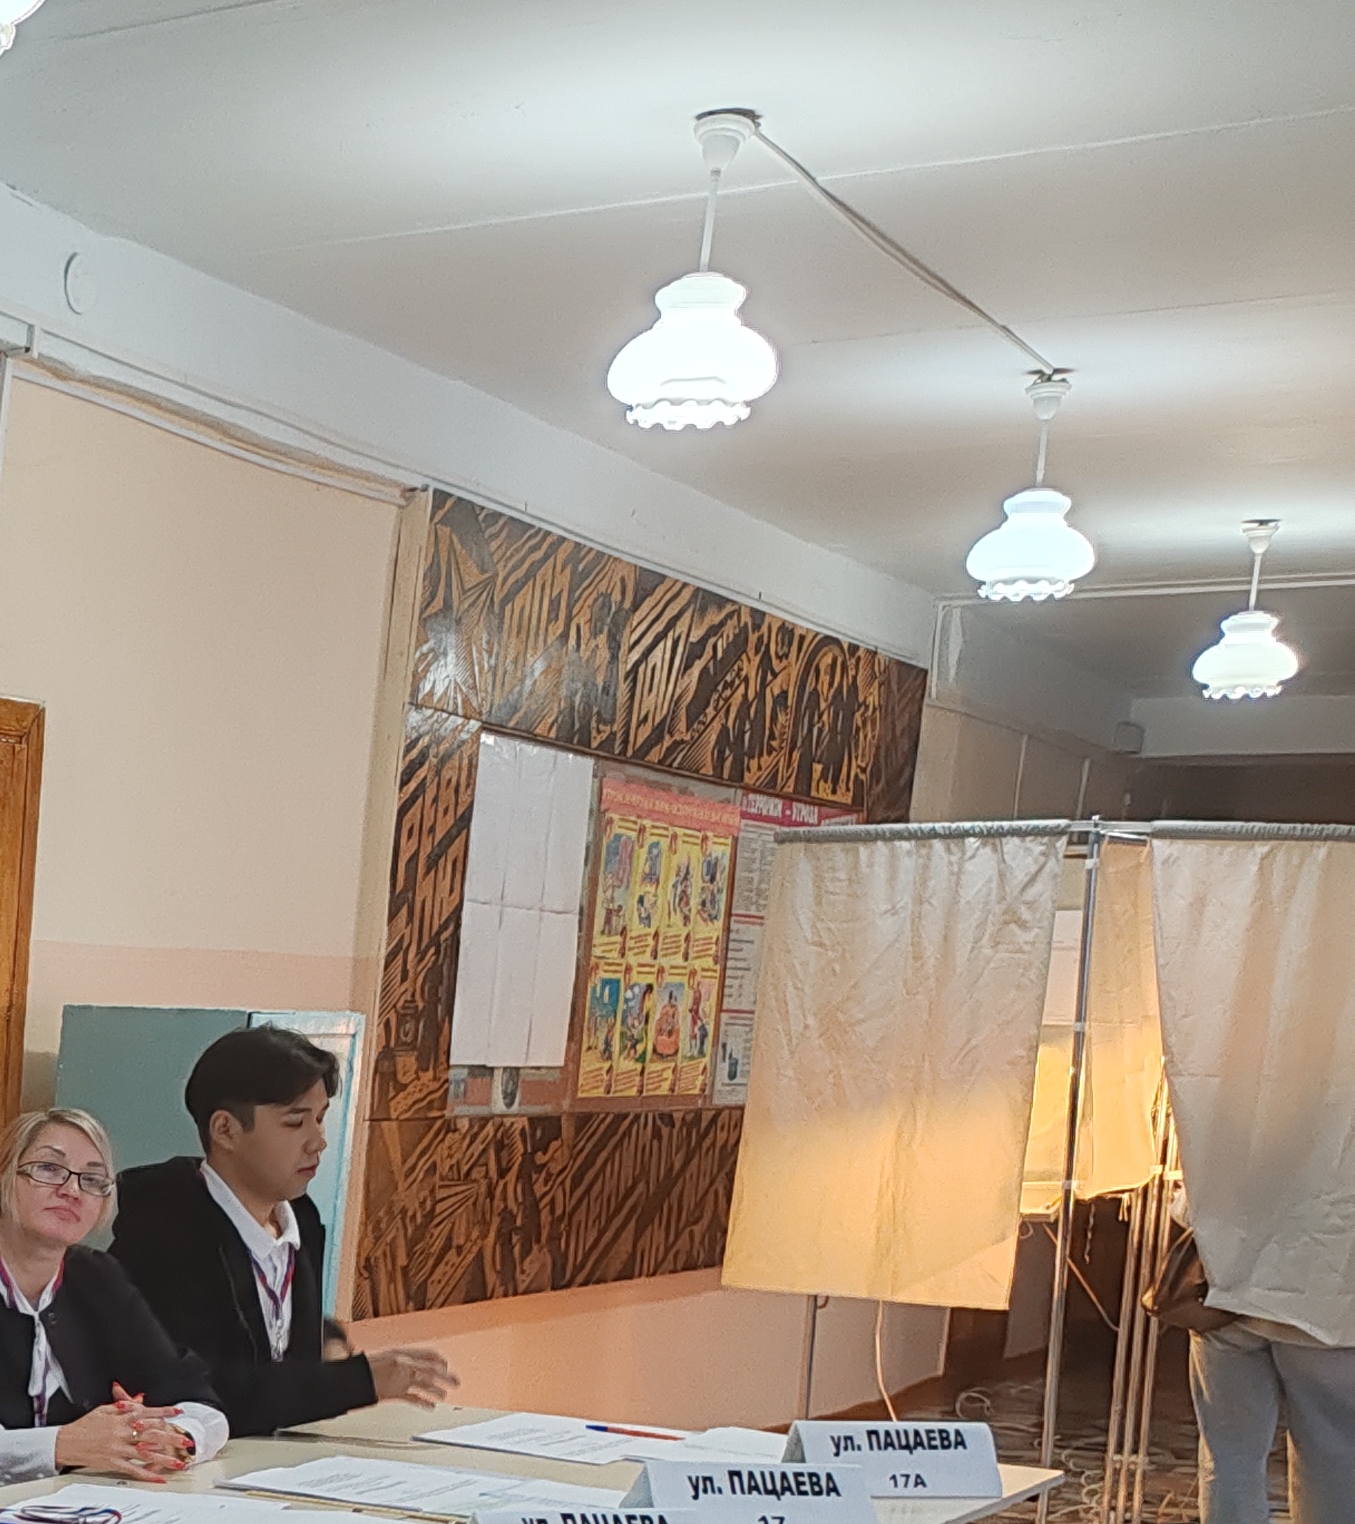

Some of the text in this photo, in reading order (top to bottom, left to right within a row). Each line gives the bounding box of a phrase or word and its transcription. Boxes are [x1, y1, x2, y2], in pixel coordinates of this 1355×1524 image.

[831, 1429, 967, 1457] ул. ПАЦАЕВА
[688, 1470, 841, 1501] ул. ПАЦАЕВА
[890, 1474, 926, 1487] 17А
